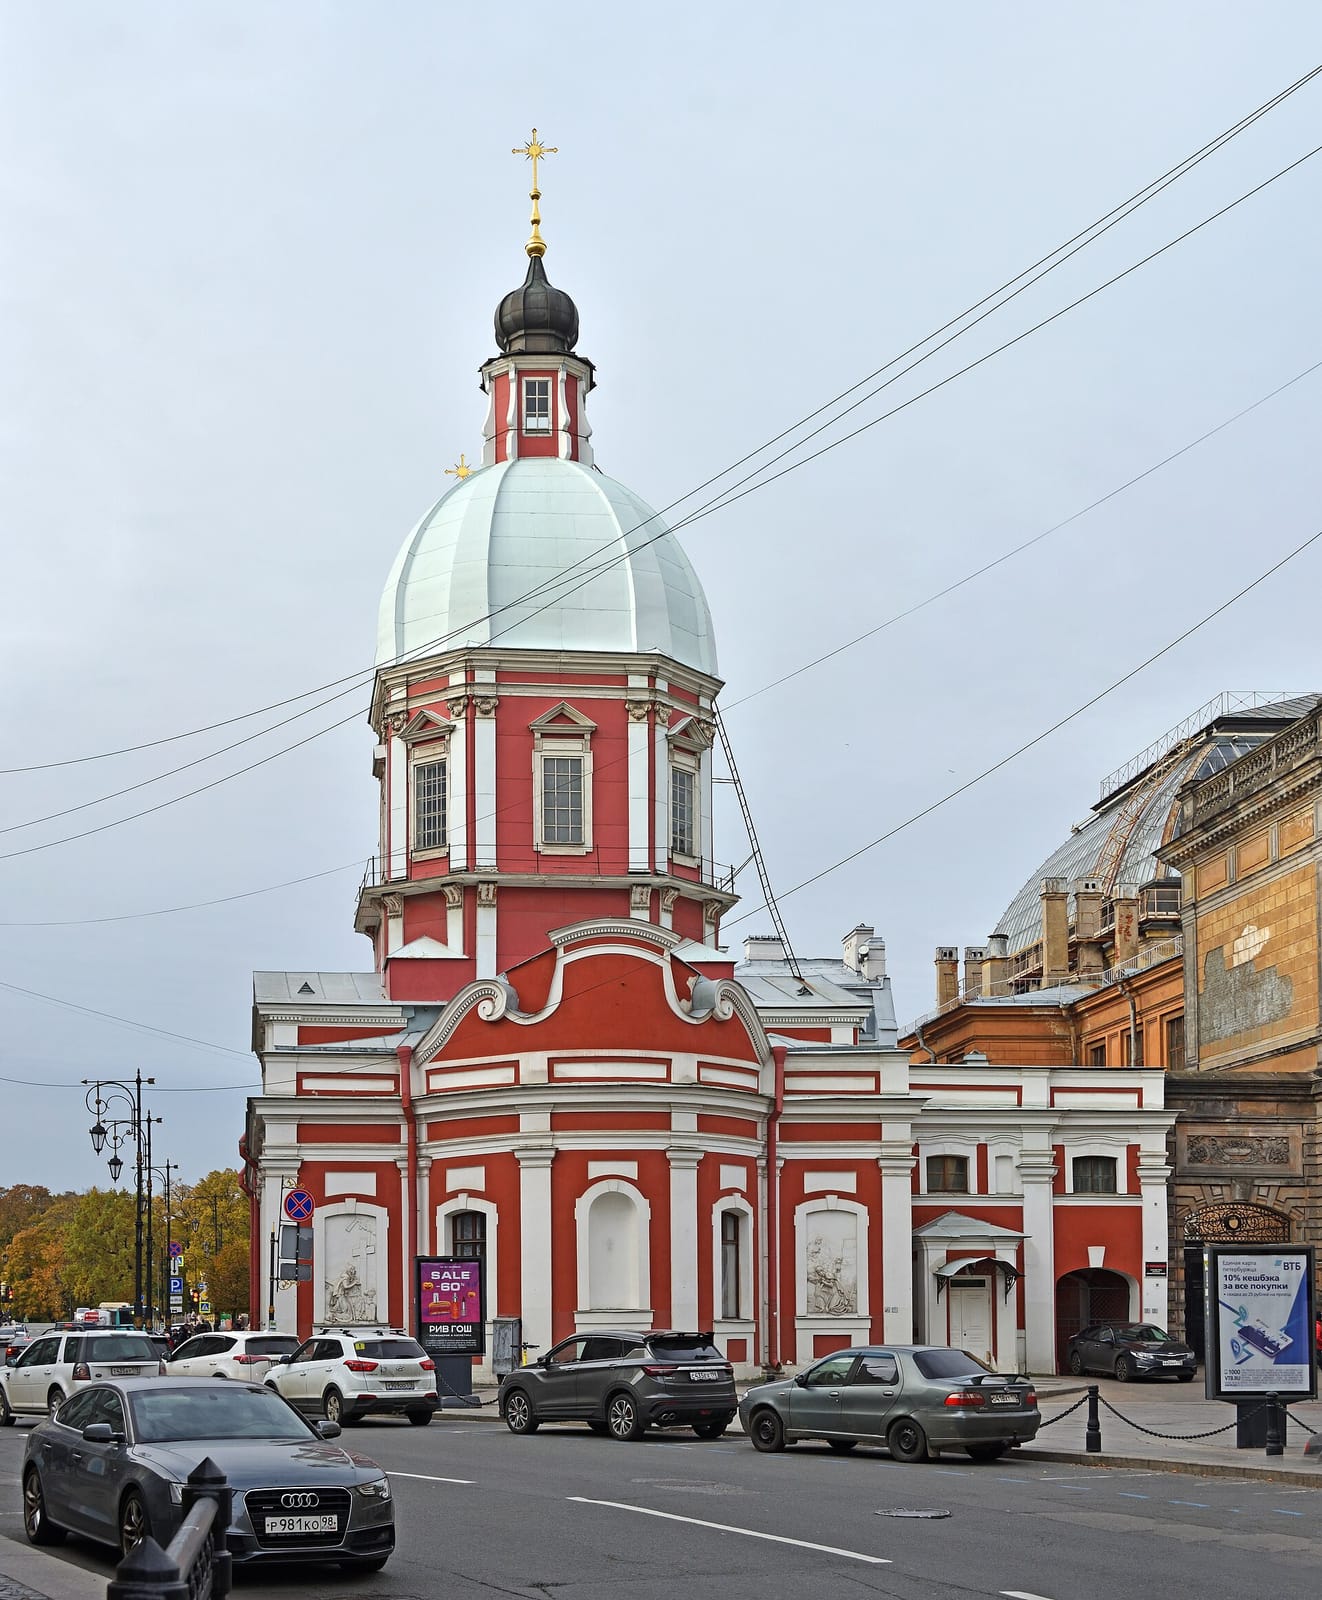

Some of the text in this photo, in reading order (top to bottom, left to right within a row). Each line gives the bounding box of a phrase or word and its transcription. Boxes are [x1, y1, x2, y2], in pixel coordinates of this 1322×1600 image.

[1283, 1262, 1301, 1271] ВТБ
[431, 1271, 471, 1280] SALE
[1223, 1274, 1280, 1282] 10% кешбэка
[1250, 1283, 1289, 1291] покупки
[429, 1324, 472, 1333] РИВ ГОШ
